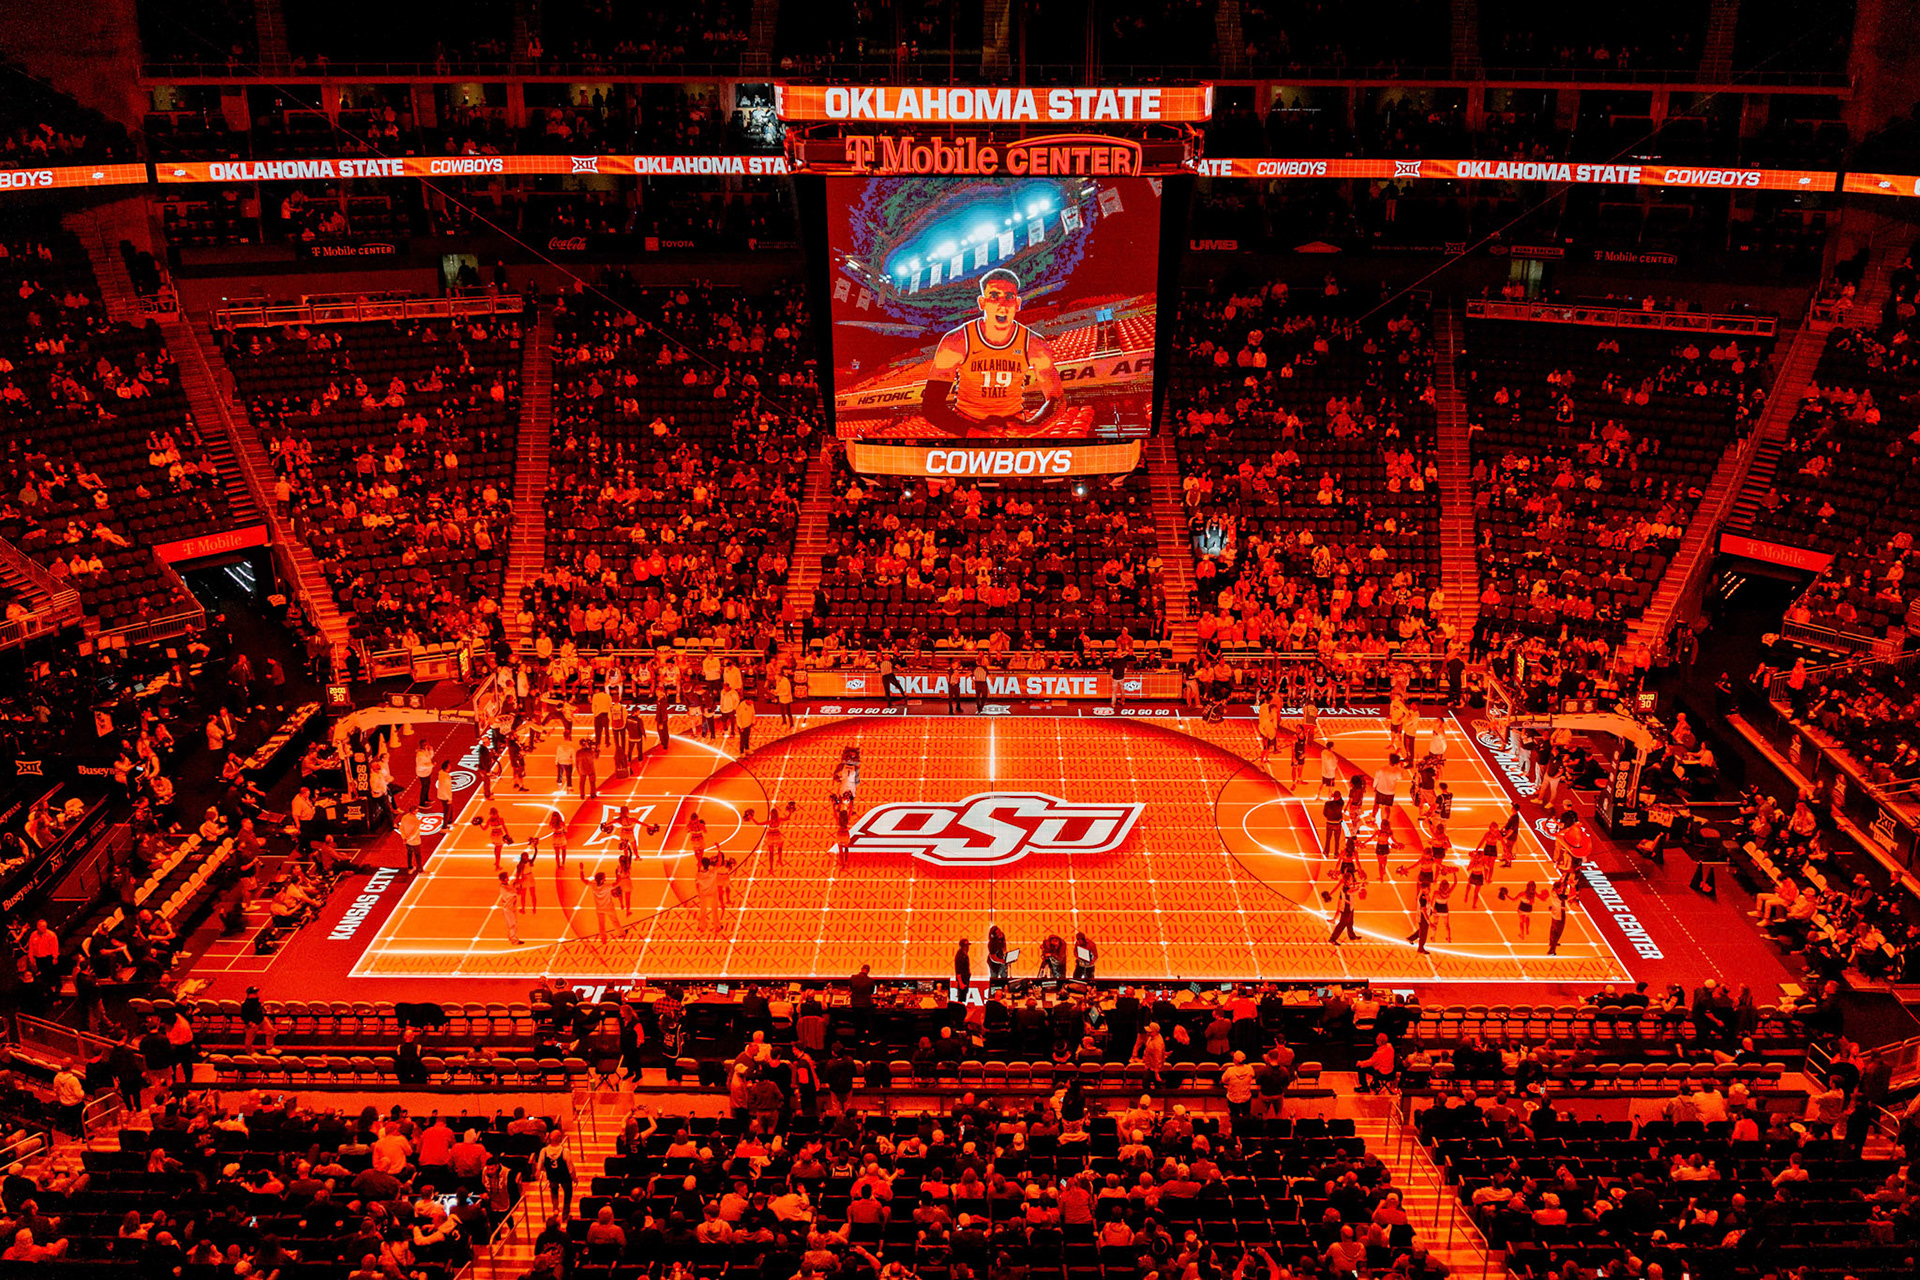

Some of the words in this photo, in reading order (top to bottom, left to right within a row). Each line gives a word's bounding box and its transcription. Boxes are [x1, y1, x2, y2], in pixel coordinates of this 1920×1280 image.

[825, 87, 1038, 119] OKLAHOMA
[1048, 88, 1161, 119] STATE
[879, 136, 998, 175] Mobile
[1006, 146, 1132, 175] CENTER
[209, 160, 335, 180] OKLAHOMA
[339, 159, 404, 178] STATE
[430, 159, 503, 174] COWBOYS
[634, 157, 745, 174] OKLAHOMA
[1256, 161, 1327, 176] COWBOYS
[1457, 161, 1571, 181] OKLAHOMA
[1576, 164, 1642, 184] STATE
[1663, 169, 1761, 187] COWBOYS
[661, 240, 695, 248] TOYOTA
[1190, 239, 1238, 250] UMB
[322, 245, 356, 257] Mobile
[358, 245, 392, 256] CENTER
[1605, 251, 1638, 263] Mobile
[1639, 253, 1674, 264] CENTER
[971, 359, 1022, 373] OKLAHOMA
[981, 371, 1012, 387] 19
[857, 390, 915, 405] HISTORIC
[981, 387, 1008, 398] STATE
[926, 450, 1072, 475] COWBOYS
[198, 534, 243, 553] Mobile
[1760, 544, 1806, 564] Mobile
[1026, 676, 1098, 695] STATE
[333, 693, 344, 702] 30
[1640, 700, 1652, 708] 30
[847, 707, 863, 715] GO
[864, 707, 880, 715] GO
[881, 707, 897, 715] GO
[1120, 708, 1136, 716] GO
[1137, 708, 1153, 716] GO
[1154, 708, 1170, 716] GO
[356, 764, 367, 773] GO
[358, 773, 368, 782] GO
[1616, 772, 1628, 781] GO
[358, 781, 369, 791] GO
[1615, 780, 1627, 789] GO
[1614, 789, 1626, 798] GO
[835, 793, 1144, 865] OSU
[327, 895, 380, 940] KANSAS
[363, 867, 400, 893] CITY
[1580, 861, 1631, 912] T-MOBILE
[1613, 914, 1664, 960] CENTER
[551, 1159, 558, 1169] 3
